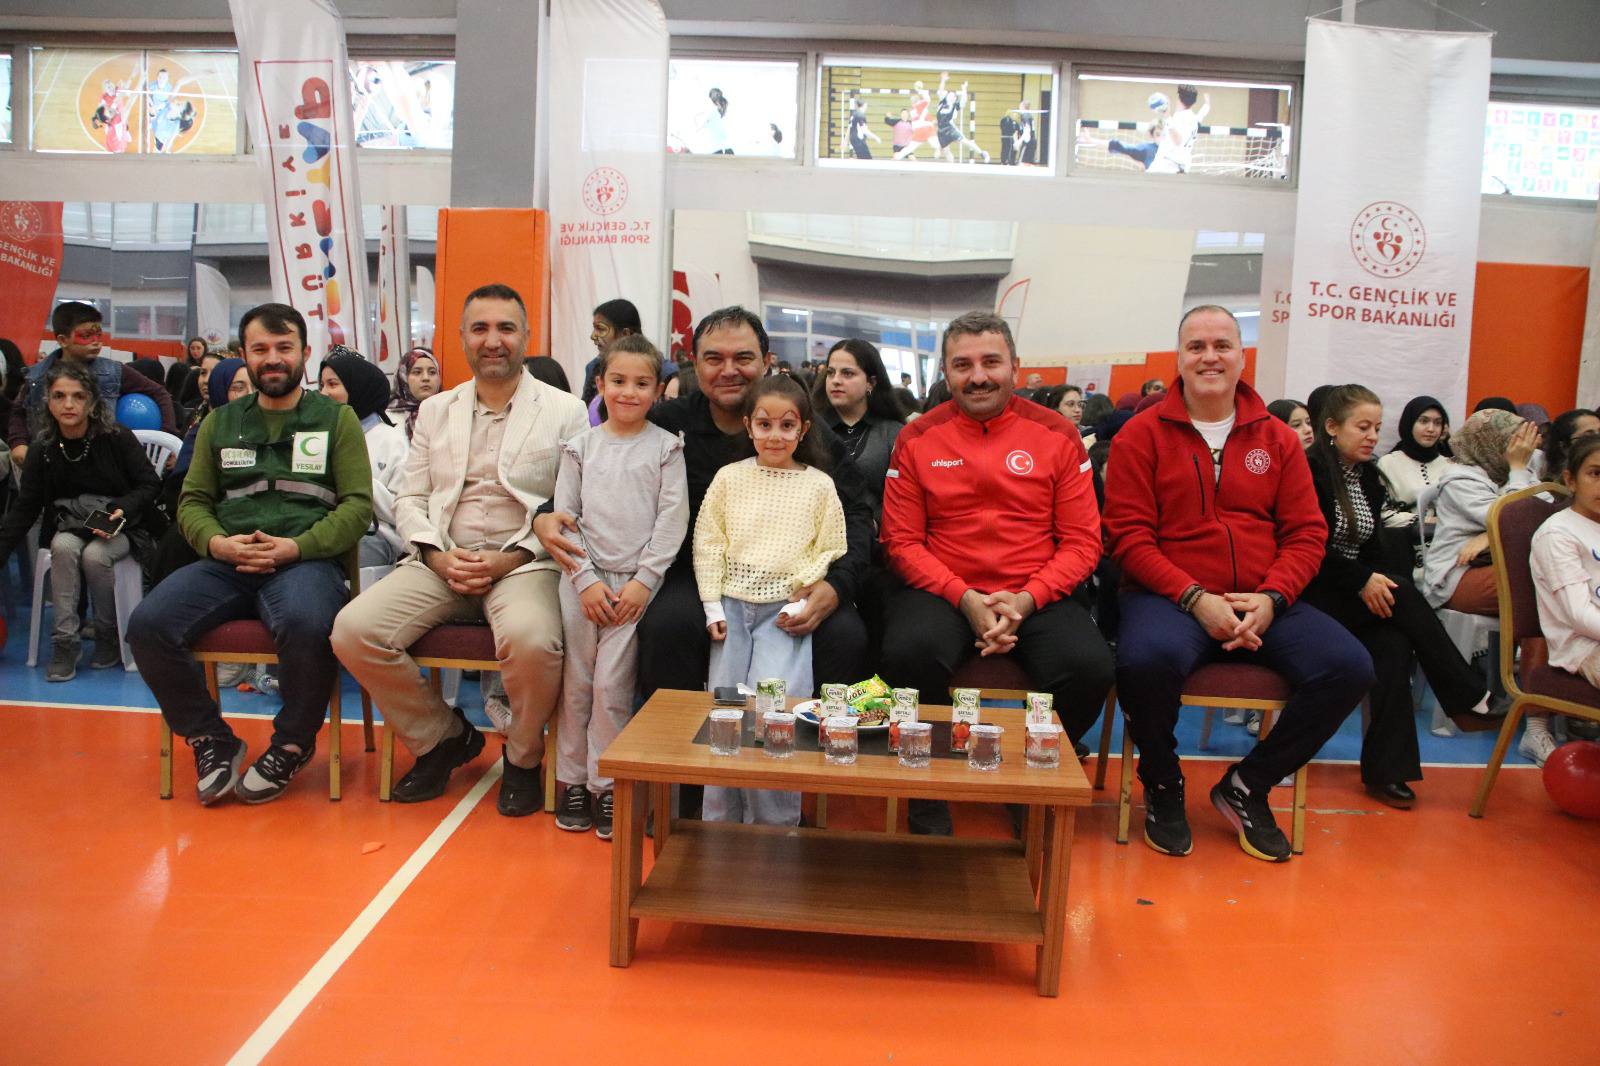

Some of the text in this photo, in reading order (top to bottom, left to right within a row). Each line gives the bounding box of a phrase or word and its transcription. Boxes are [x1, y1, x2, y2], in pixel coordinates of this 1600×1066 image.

[42, 255, 56, 267] VE
[1309, 281, 1457, 308] T.C. GENÇLİK VE
[1308, 302, 1456, 328] SPOR BAKANLIĞI
[931, 458, 963, 468] uhlsport
